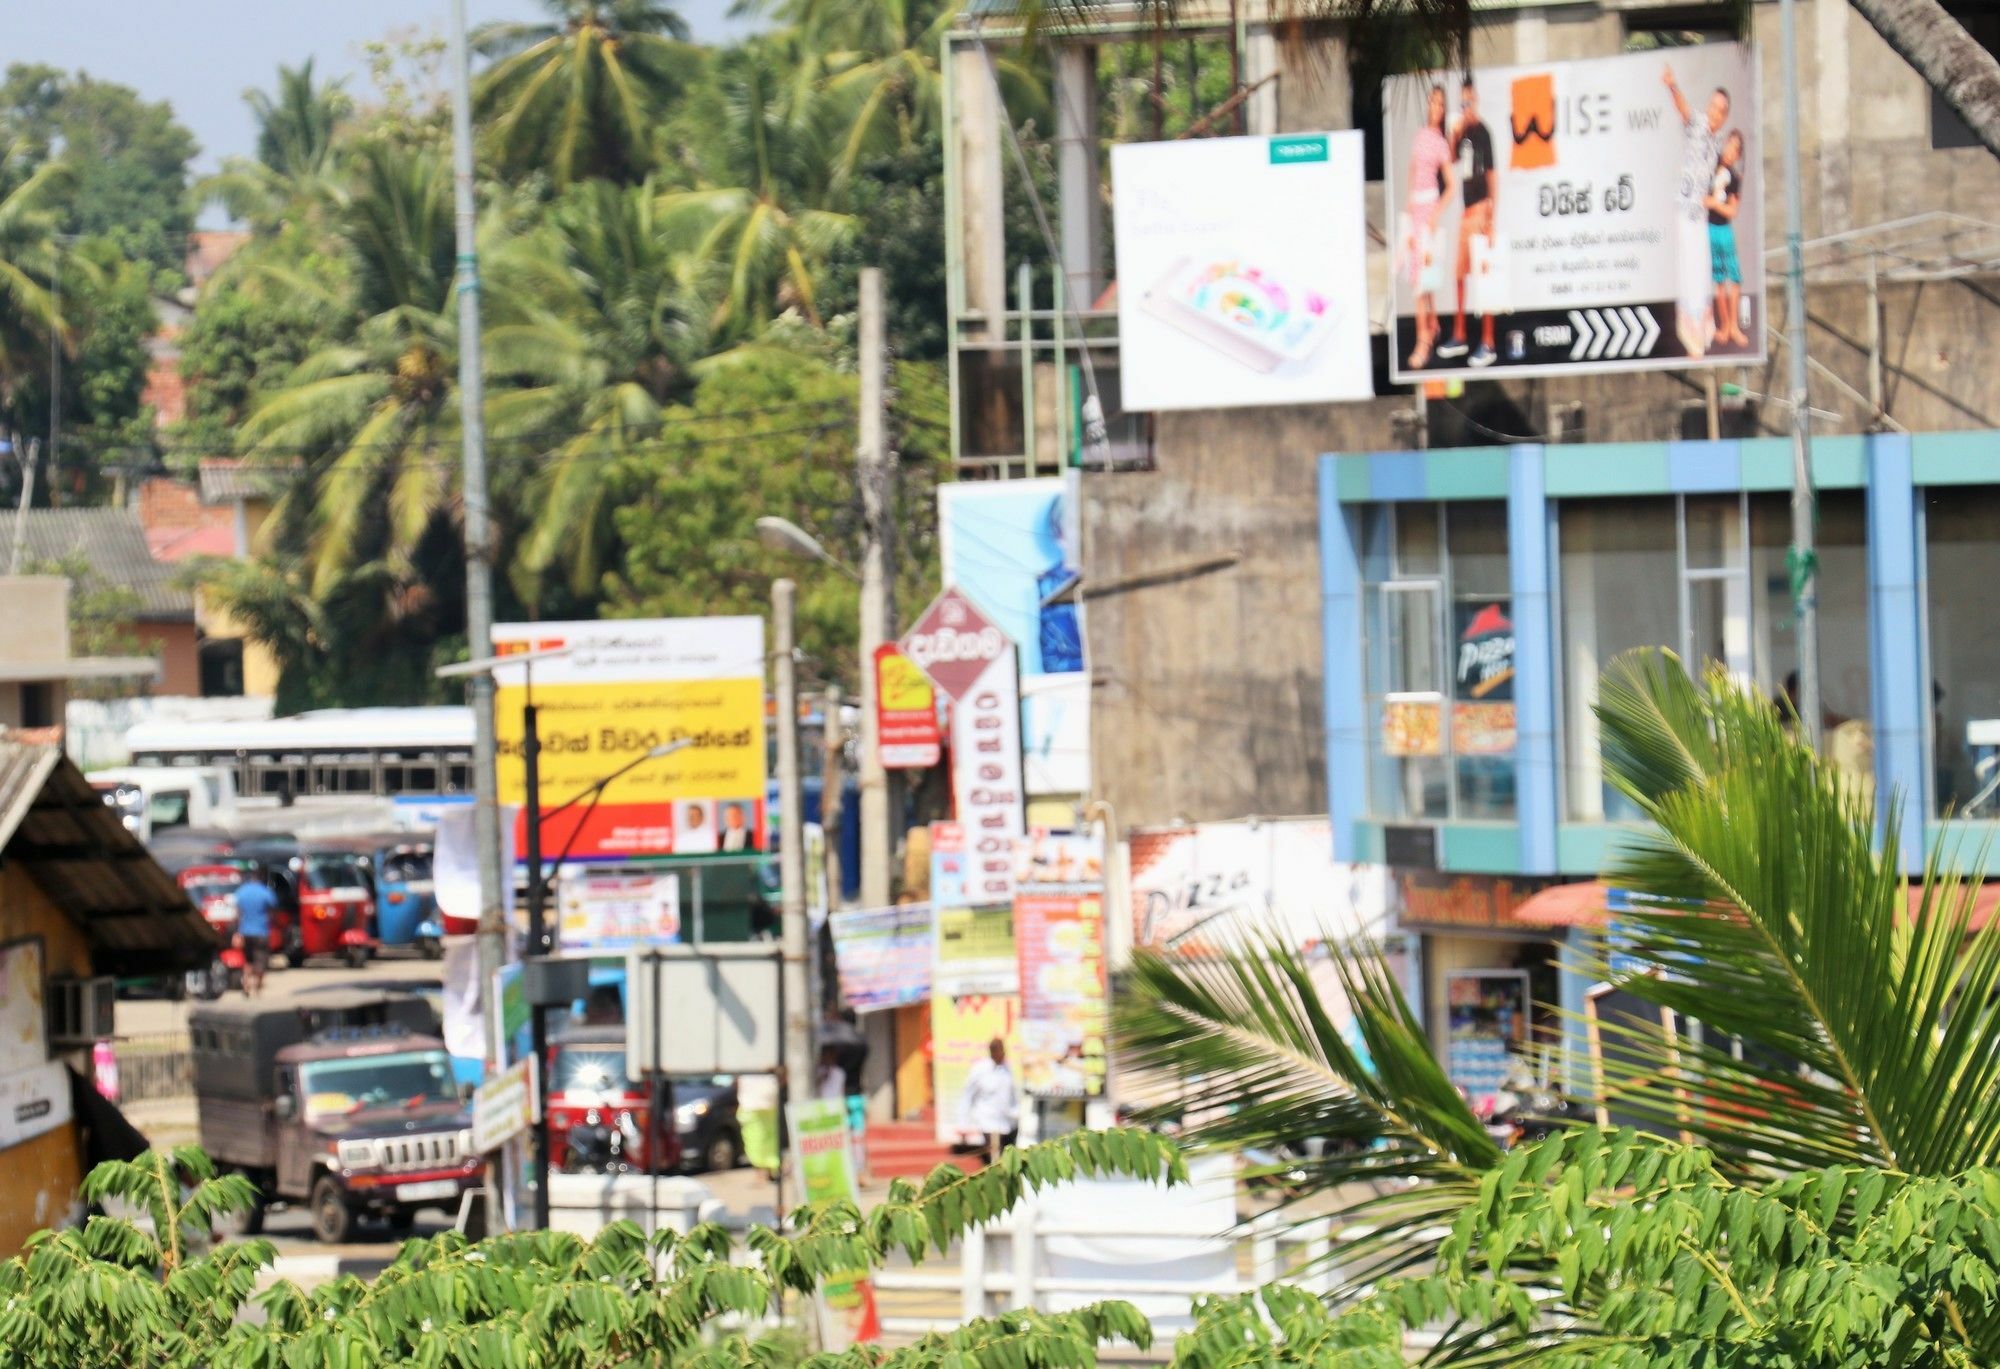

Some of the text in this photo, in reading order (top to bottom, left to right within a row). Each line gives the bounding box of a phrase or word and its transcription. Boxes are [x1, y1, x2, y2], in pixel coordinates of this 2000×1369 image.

[1510, 93, 1663, 144] WISE WAY
[1143, 870, 1249, 945] Pizza
